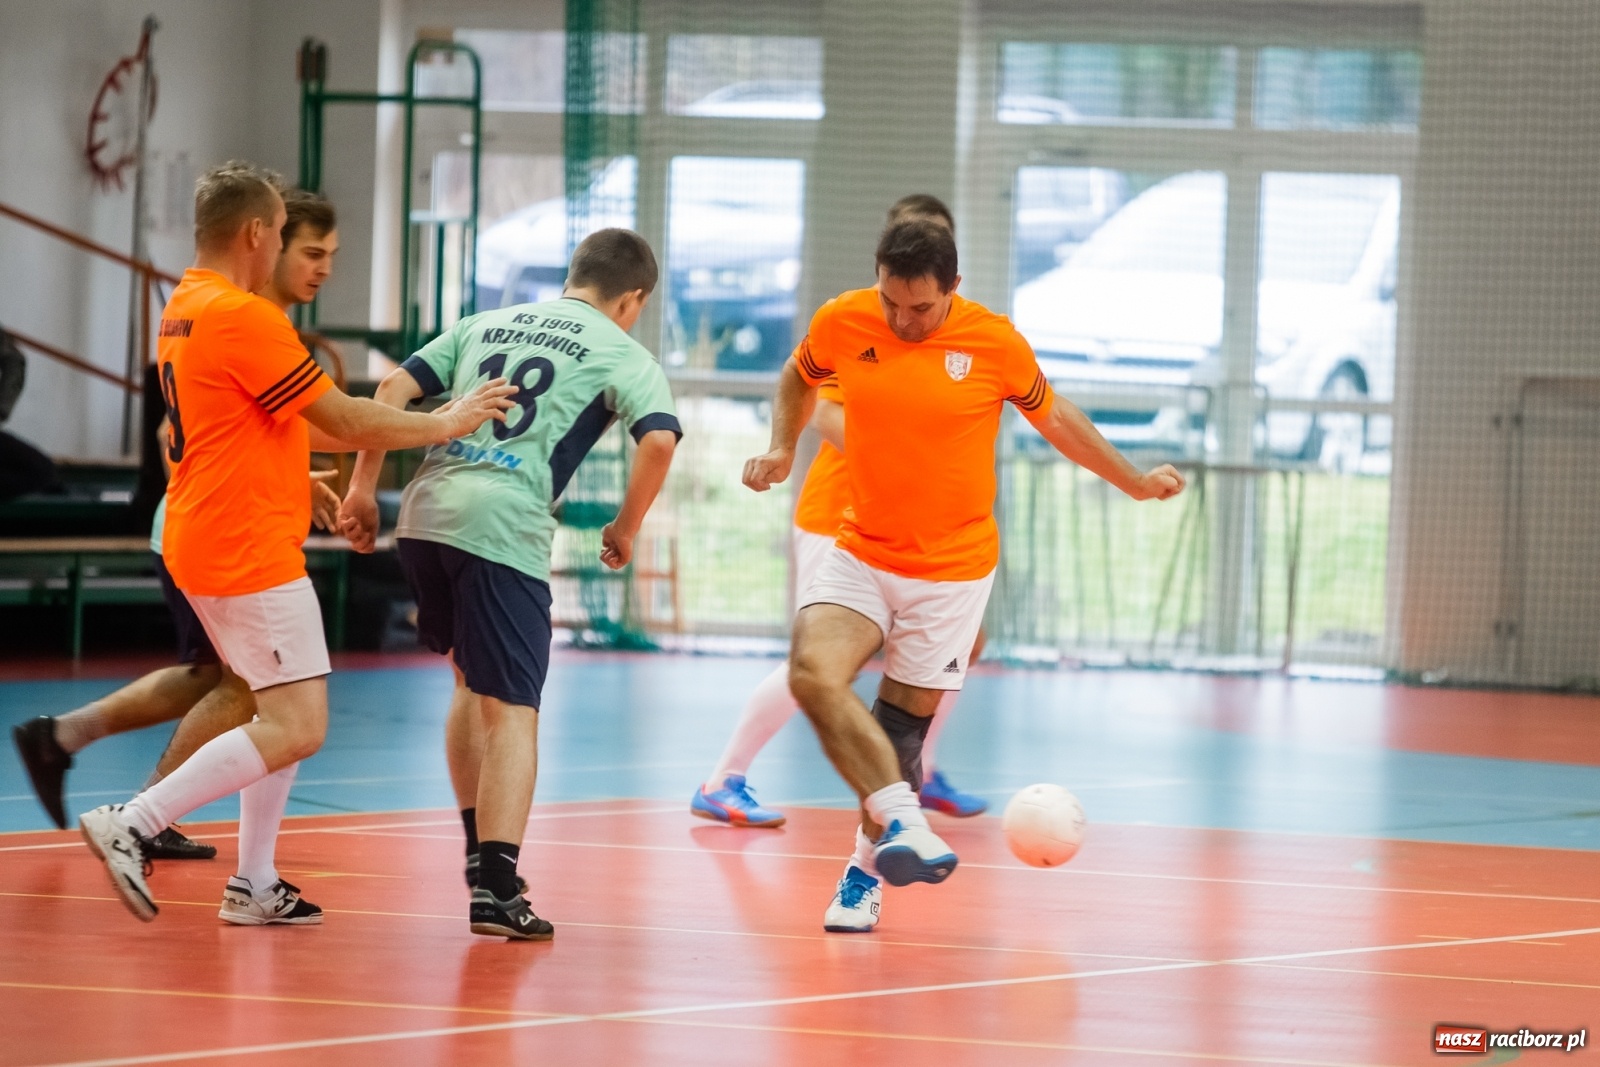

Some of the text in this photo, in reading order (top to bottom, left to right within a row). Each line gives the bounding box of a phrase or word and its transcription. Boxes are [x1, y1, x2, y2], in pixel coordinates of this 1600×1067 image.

[481, 327, 590, 363] KRZANOWICE
[512, 312, 585, 335] KS 1905
[162, 361, 186, 464] 9
[478, 353, 555, 441] 18
